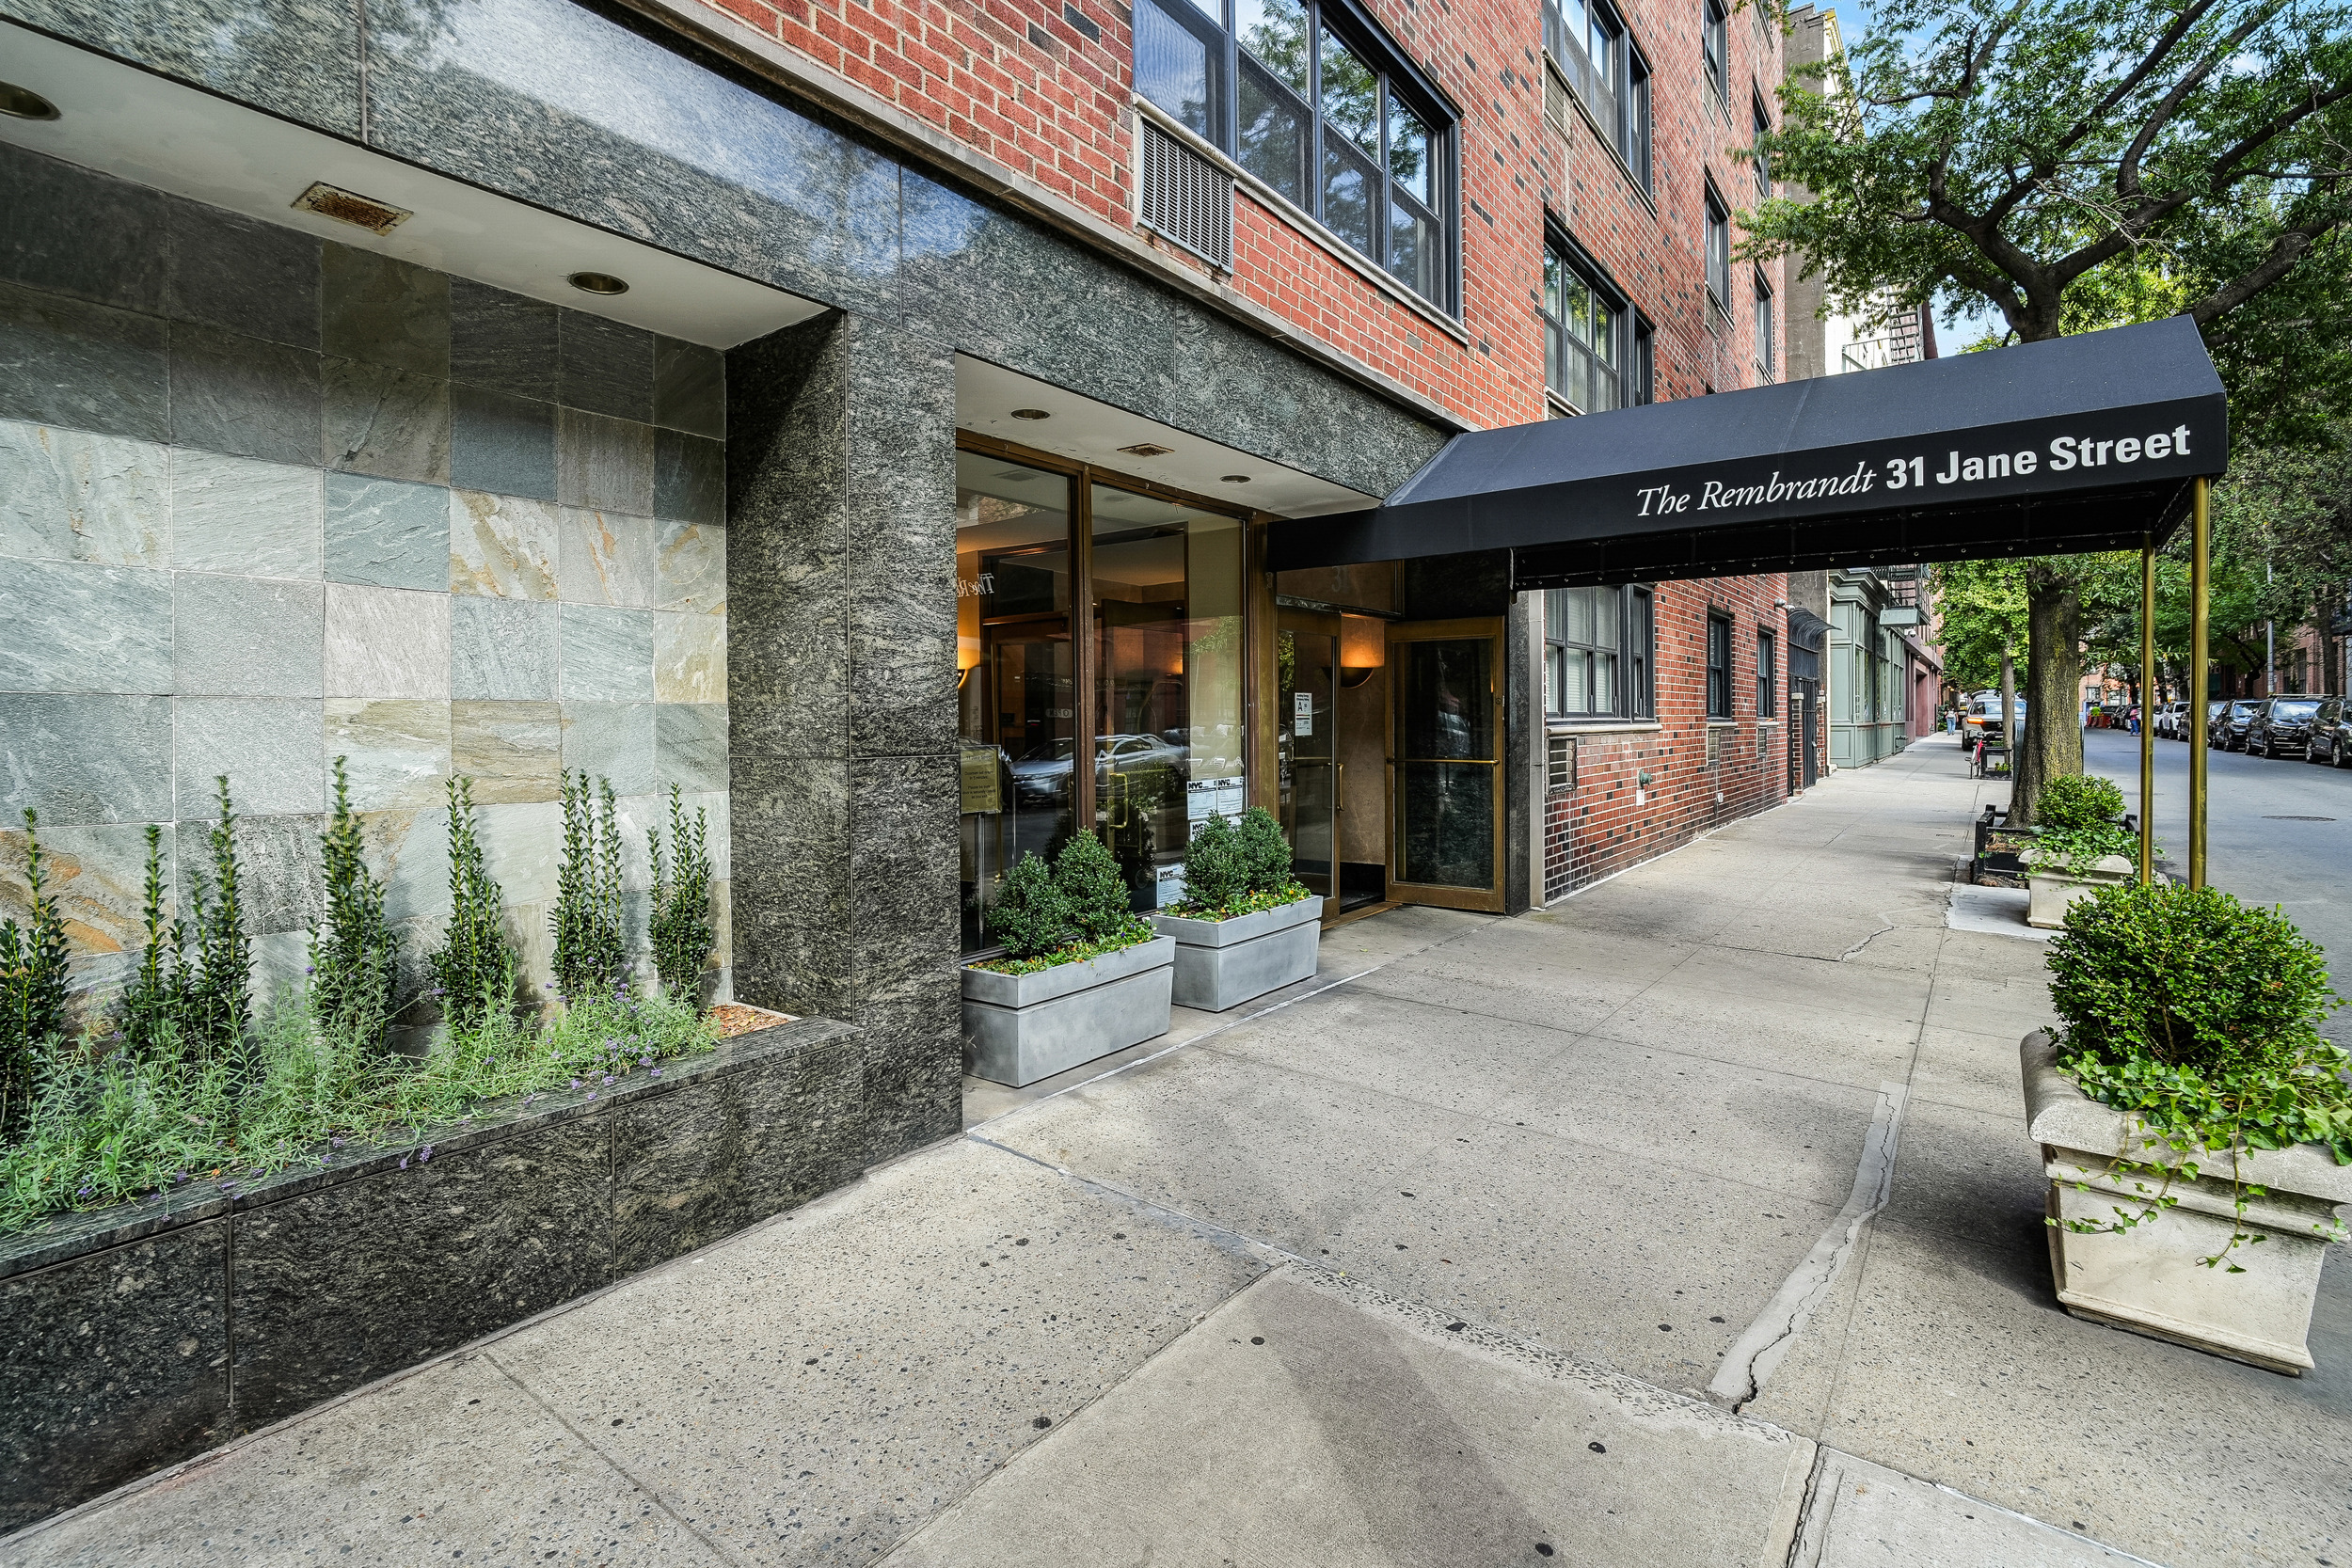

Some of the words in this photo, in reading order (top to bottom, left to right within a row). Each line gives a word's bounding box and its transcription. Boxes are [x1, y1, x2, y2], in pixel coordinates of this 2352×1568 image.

[1637, 484, 1691, 516] The
[1697, 461, 1877, 511] Rembrandt
[1886, 456, 1924, 489] 31
[1936, 451, 2037, 485] Jane
[2049, 424, 2191, 471] Street
[1188, 782, 1203, 790] NYC
[1159, 870, 1174, 879] NYC
